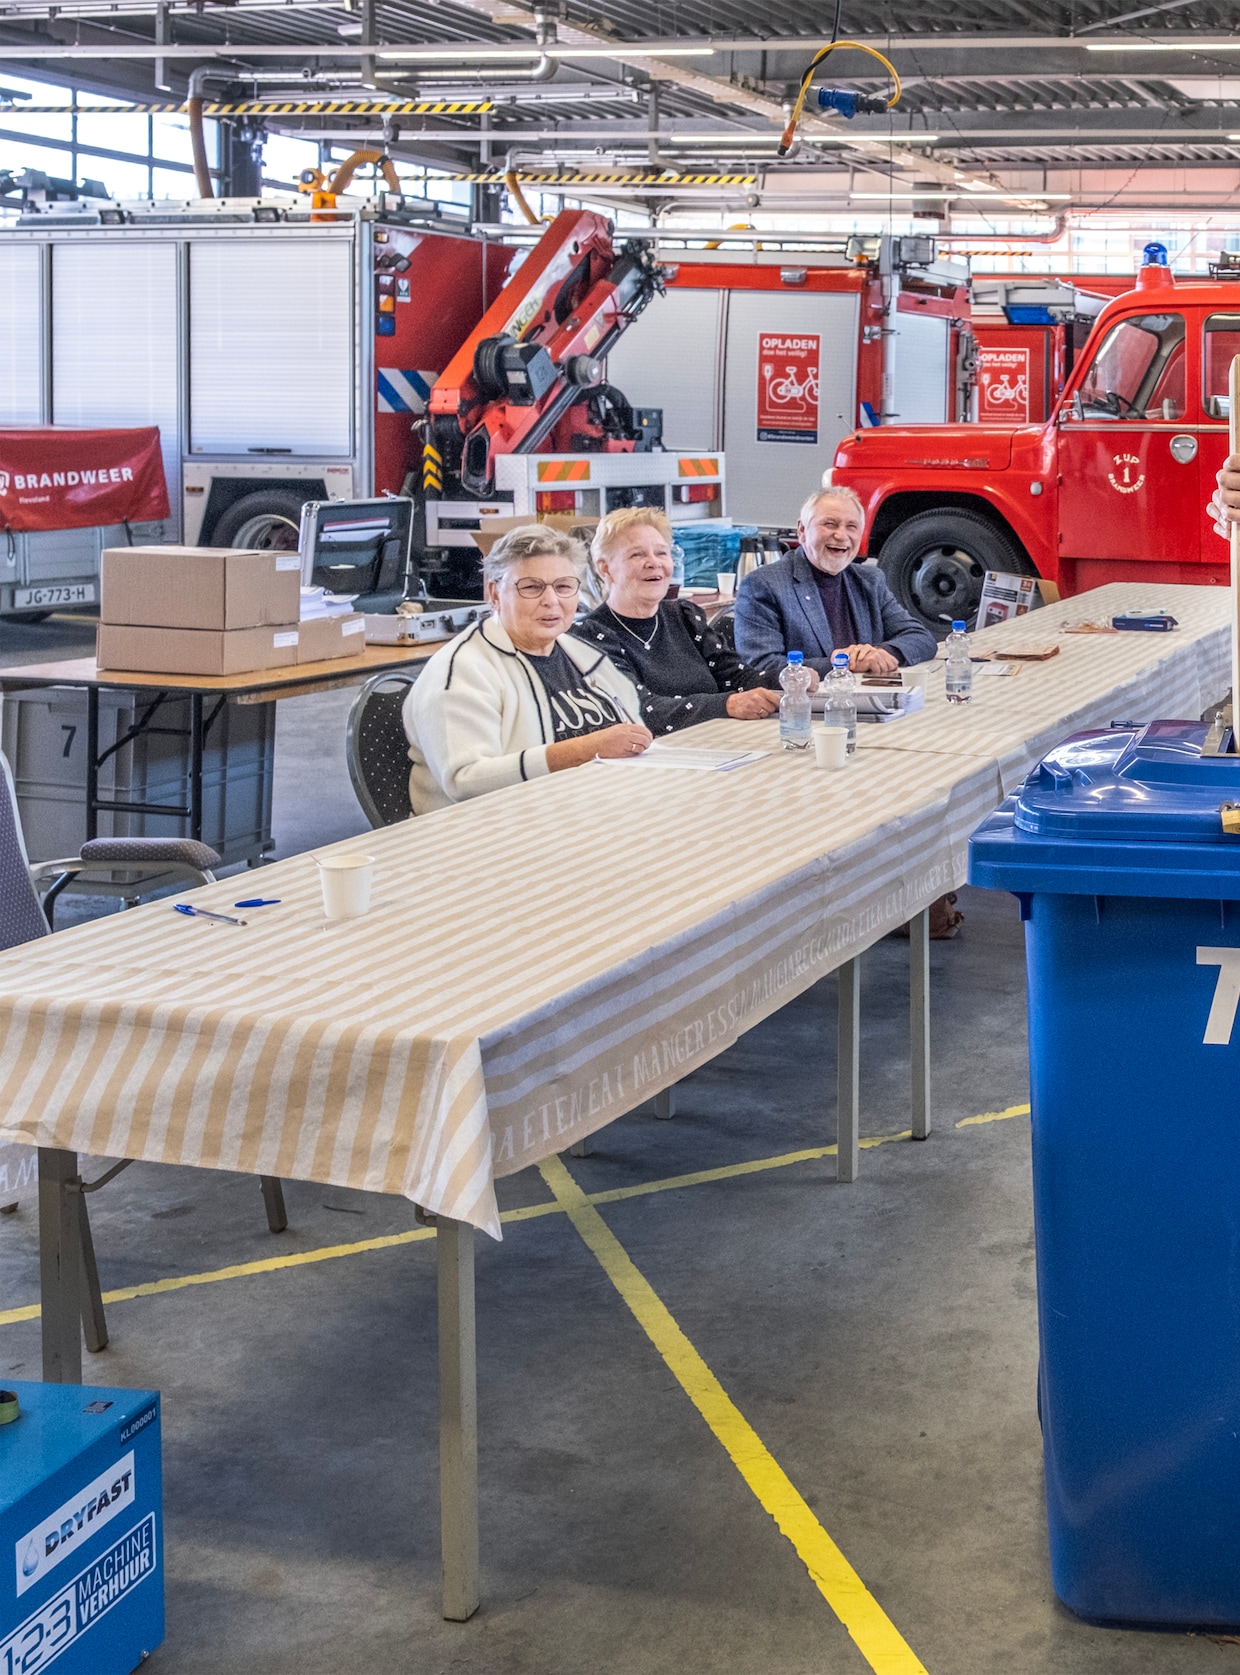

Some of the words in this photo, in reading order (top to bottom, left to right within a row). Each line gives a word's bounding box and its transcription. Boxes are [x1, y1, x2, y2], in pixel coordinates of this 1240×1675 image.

[762, 338, 817, 349] OPLADEN
[981, 353, 1025, 362] OPLADEN
[1113, 453, 1140, 465] ZUP
[14, 467, 134, 490] BRANDWEER
[1123, 467, 1130, 483] 1
[25, 587, 86, 605] JG-773-H
[61, 725, 77, 757] 7
[523, 1087, 583, 1150] ETEN
[588, 1063, 625, 1116] EAT
[633, 1019, 705, 1090] MANGER
[45, 1469, 132, 1557] DRYFAST
[79, 1522, 150, 1605] MACHINE
[80, 1547, 150, 1626] VERHUUR
